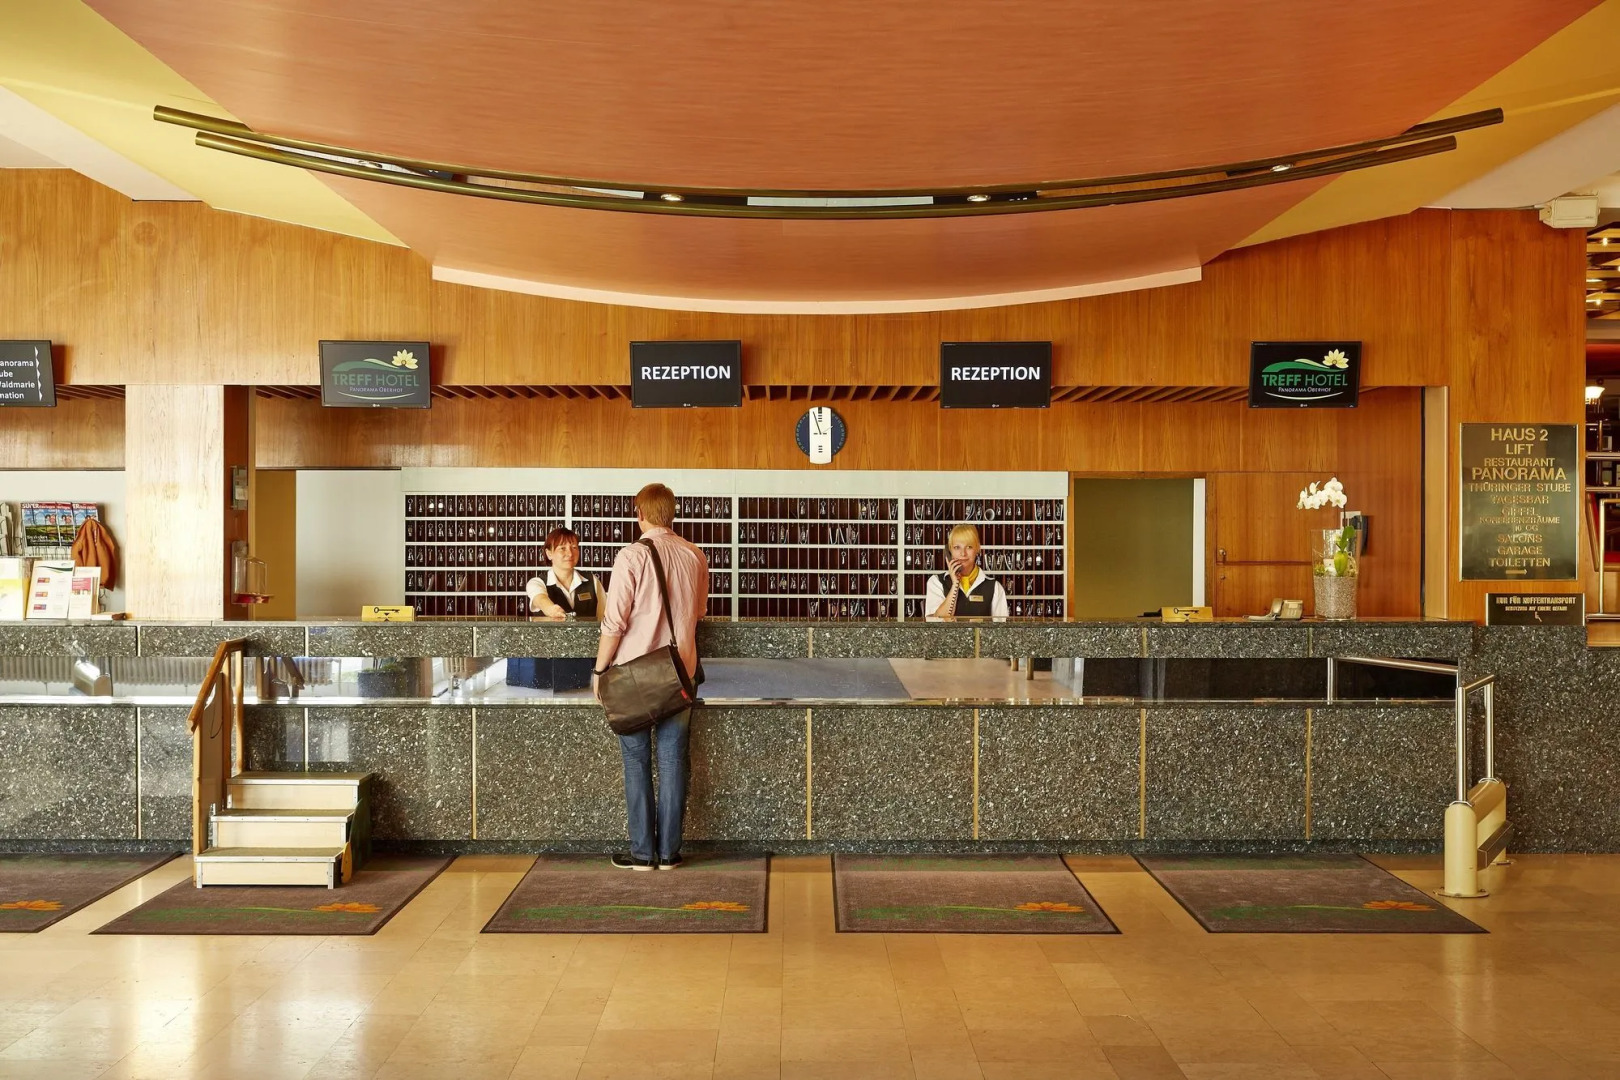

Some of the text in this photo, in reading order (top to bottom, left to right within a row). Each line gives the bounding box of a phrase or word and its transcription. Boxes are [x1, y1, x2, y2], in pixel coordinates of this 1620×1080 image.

[641, 365, 731, 380] REZEPTION
[951, 366, 1041, 381] REZEPTION
[0, 380, 35, 388] aldmarie
[332, 374, 420, 386] TREFF HOTEL
[1262, 374, 1348, 386] TREFF HOTEL
[1490, 428, 1548, 441] HAUS 2
[1506, 444, 1533, 454] LIFT
[1484, 458, 1555, 467] RESTAURANT
[1472, 467, 1566, 480] PANORAMA
[1468, 482, 1571, 492] THÜRINGER STUBE
[1497, 534, 1542, 543] SALONS
[1497, 546, 1542, 555] GARAGE
[1489, 558, 1551, 567] TOILETTEN
